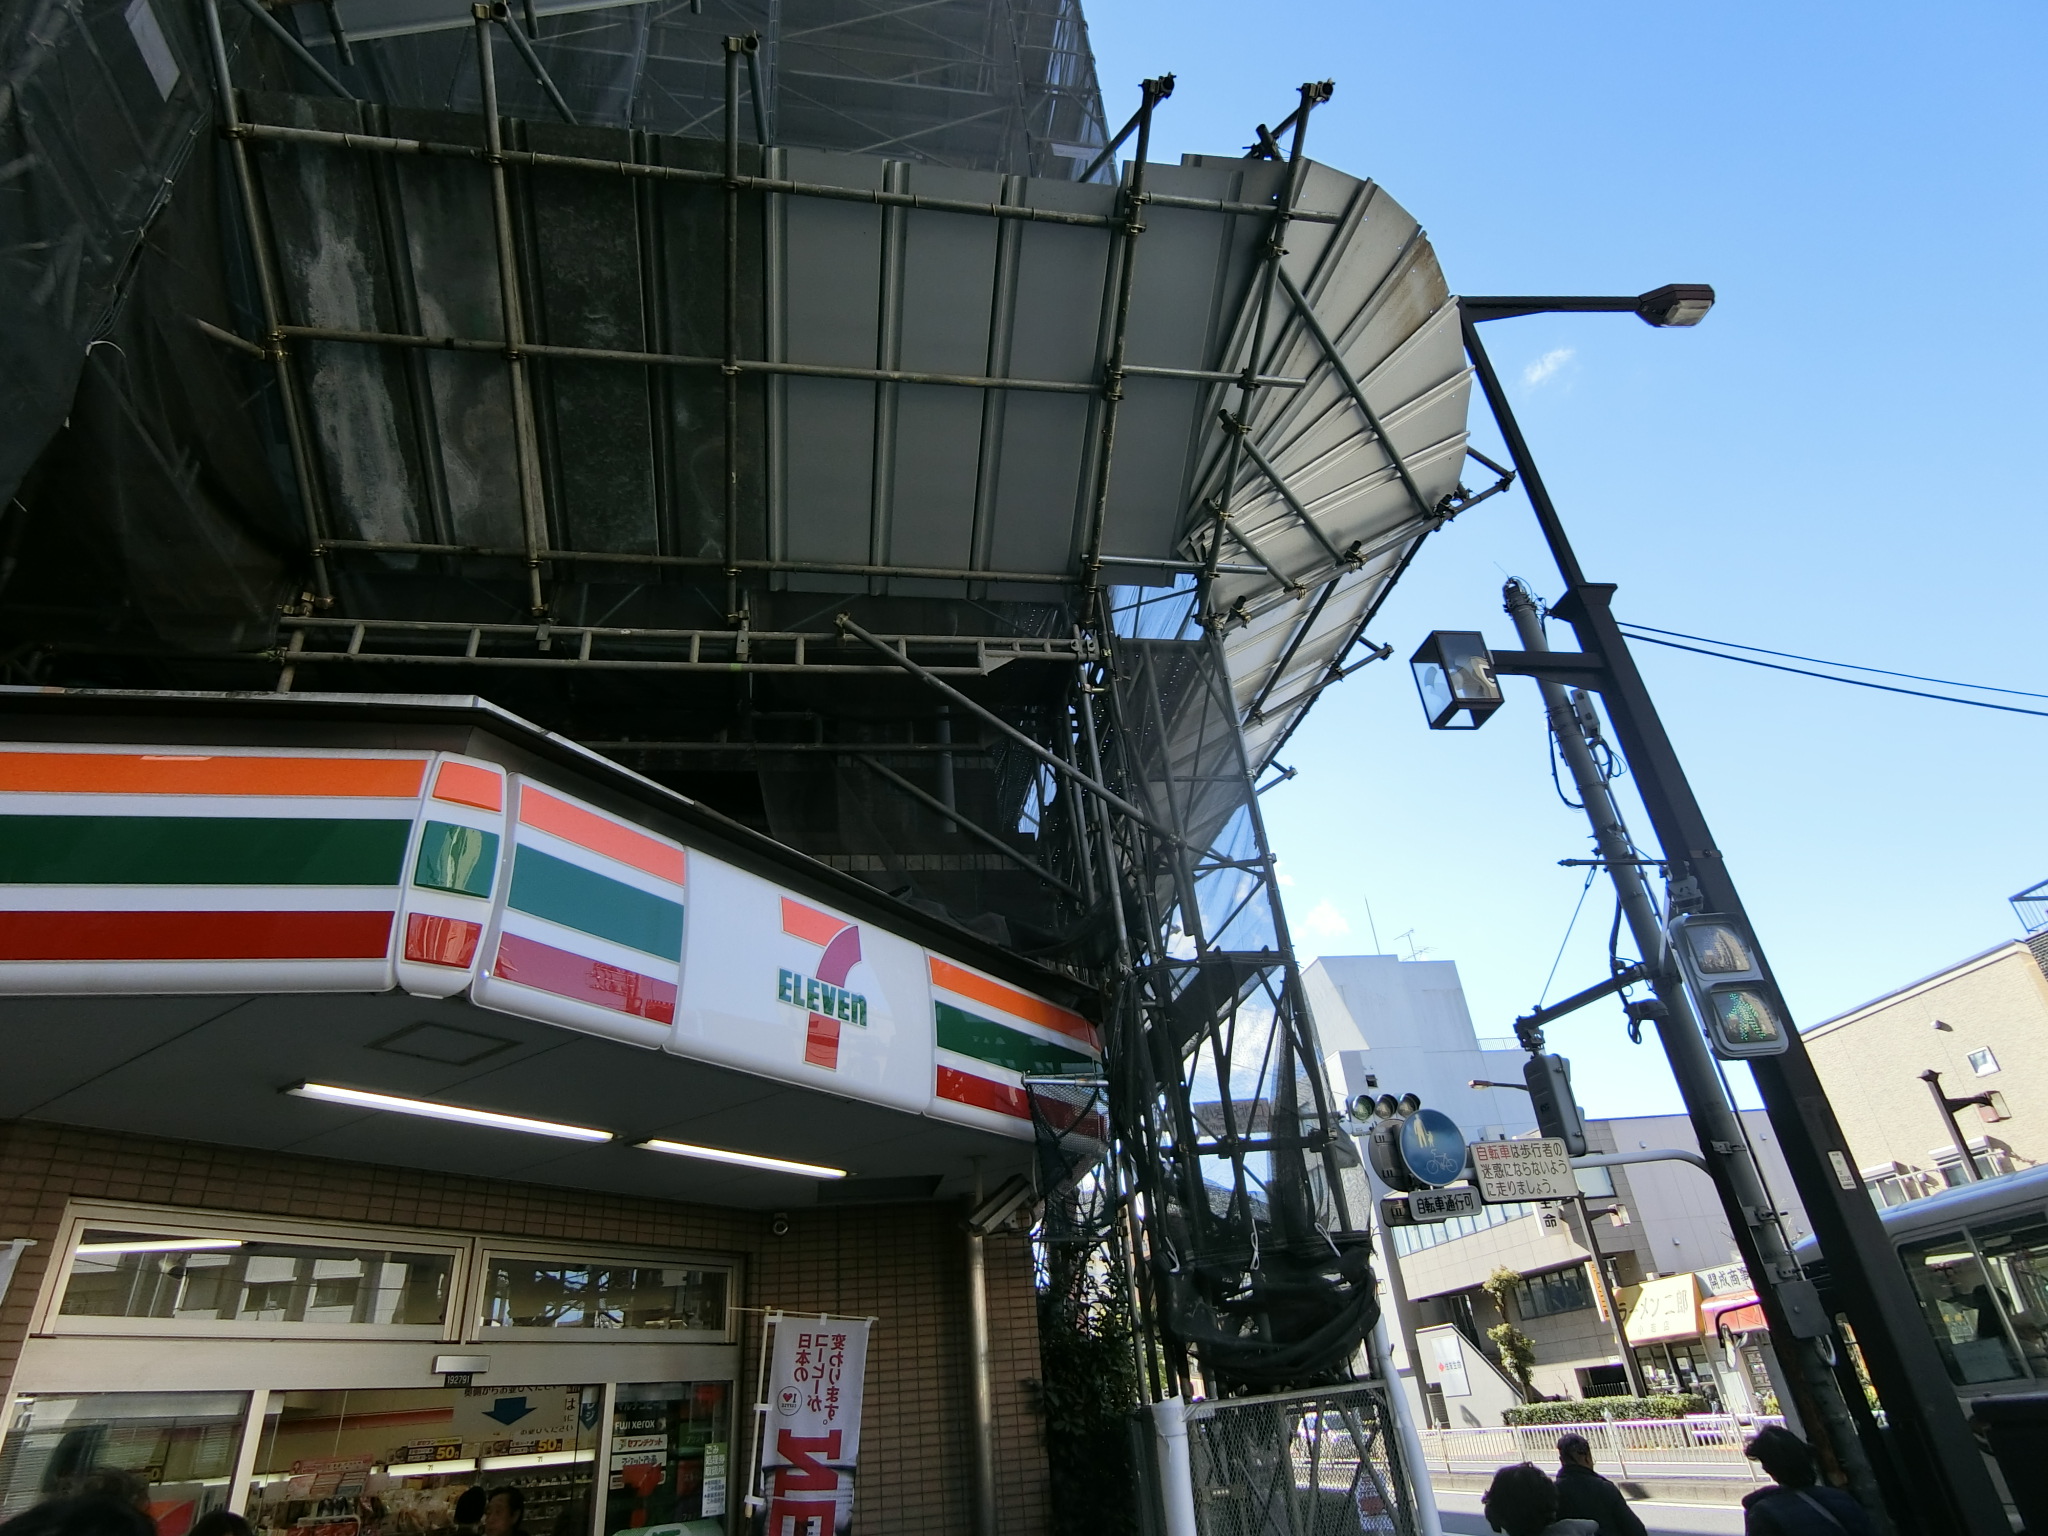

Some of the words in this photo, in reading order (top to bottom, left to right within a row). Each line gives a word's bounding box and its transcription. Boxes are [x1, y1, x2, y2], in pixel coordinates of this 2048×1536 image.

[1475, 1141, 1563, 1161] 自転車は歩行者の
[1481, 1160, 1568, 1179] 迷惑にならないよう
[1486, 1180, 1558, 1198] に走りましょう。
[1417, 1192, 1475, 1214] 自転車通行可
